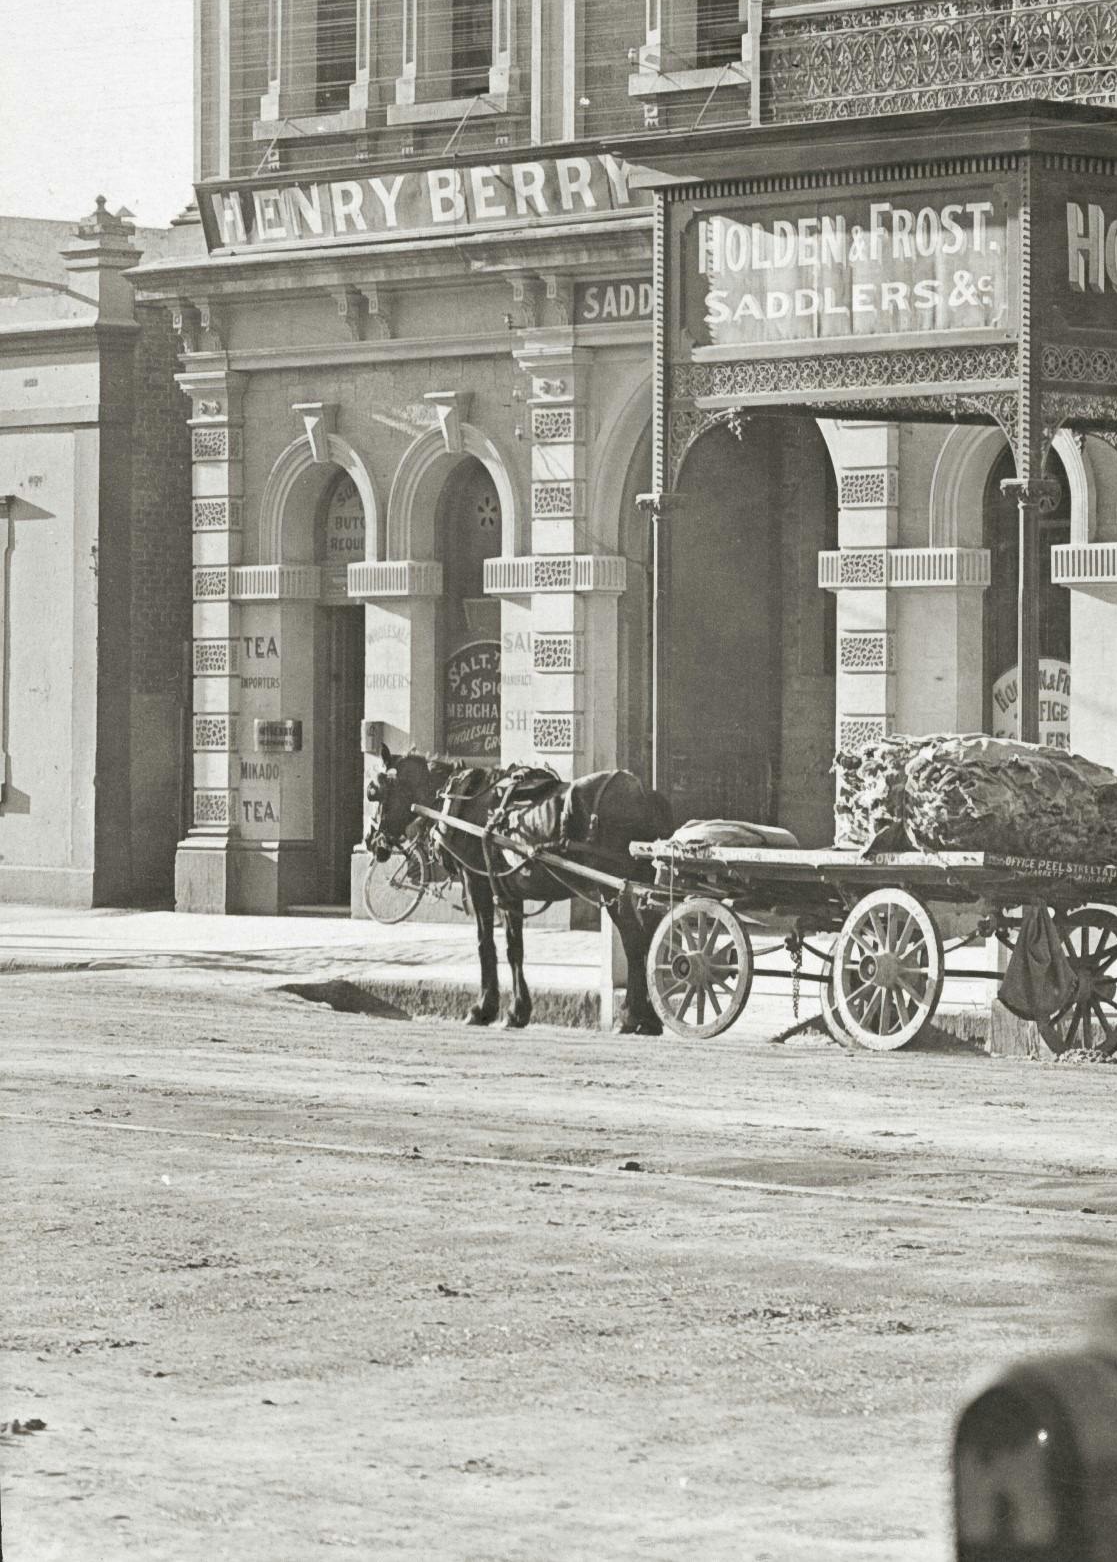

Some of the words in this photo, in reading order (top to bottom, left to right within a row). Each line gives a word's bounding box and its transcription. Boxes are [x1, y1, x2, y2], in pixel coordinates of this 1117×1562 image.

[211, 174, 405, 244] HENRY
[427, 154, 631, 223] BERRY
[699, 214, 847, 274] HOLDEN
[849, 226, 867, 262] &
[870, 201, 1000, 262] FROST.
[704, 279, 941, 324] SADDLERS
[243, 636, 279, 659] TEA
[240, 676, 280, 689] IMPORTERS
[240, 761, 280, 780] MIKADO
[243, 800, 280, 823] TEA.
[1005, 855, 1036, 870] OFFICE
[1037, 859, 1066, 873] PEEL
